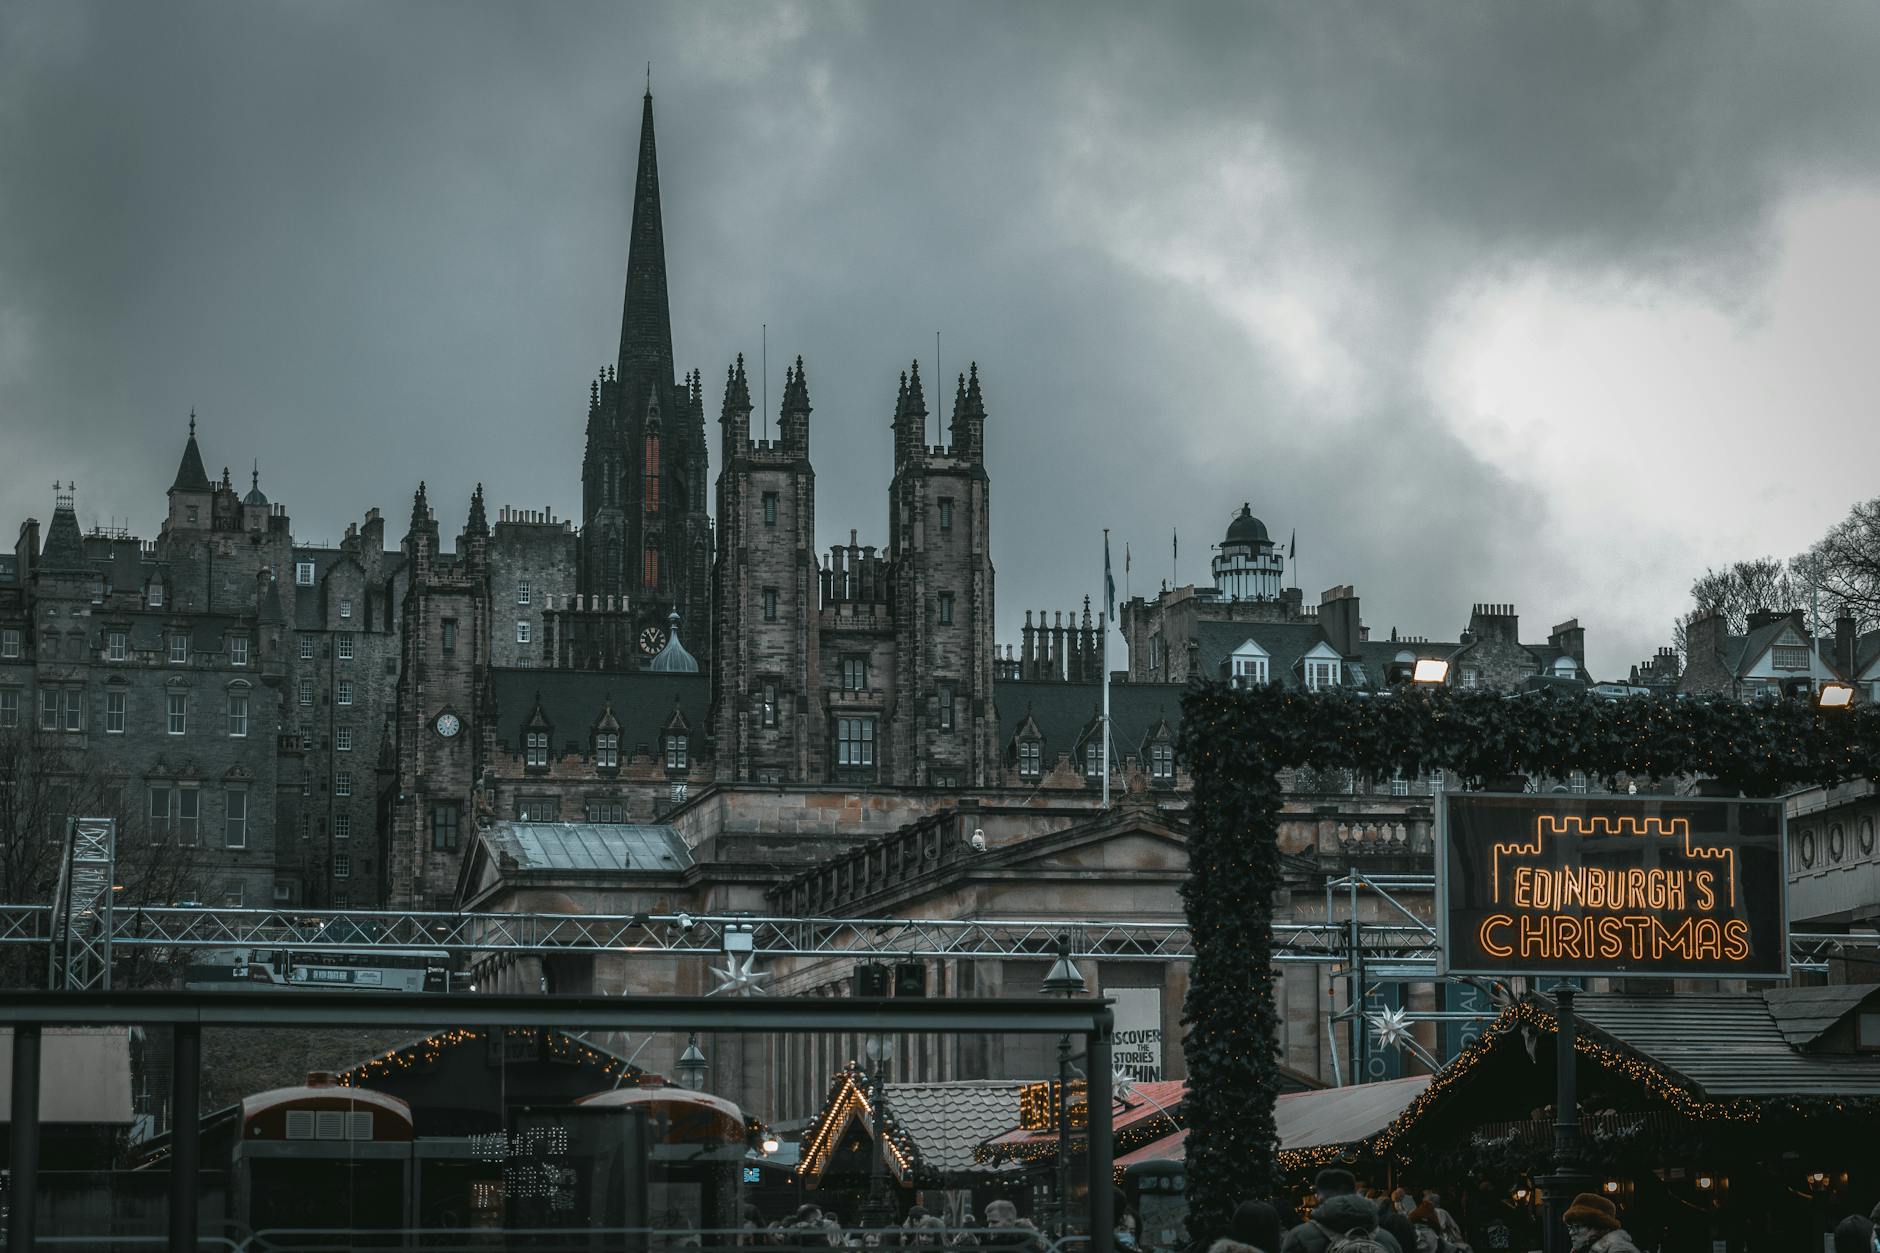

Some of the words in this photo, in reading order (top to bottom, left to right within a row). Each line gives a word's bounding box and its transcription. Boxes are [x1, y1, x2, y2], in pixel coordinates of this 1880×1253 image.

[1515, 866, 1714, 911] EDINBURGH'S
[1479, 914, 1750, 961] CHRISTMAS
[1111, 1029, 1161, 1045] ISCOVER
[1137, 1043, 1150, 1051] THE
[1113, 1052, 1154, 1063] STORIES
